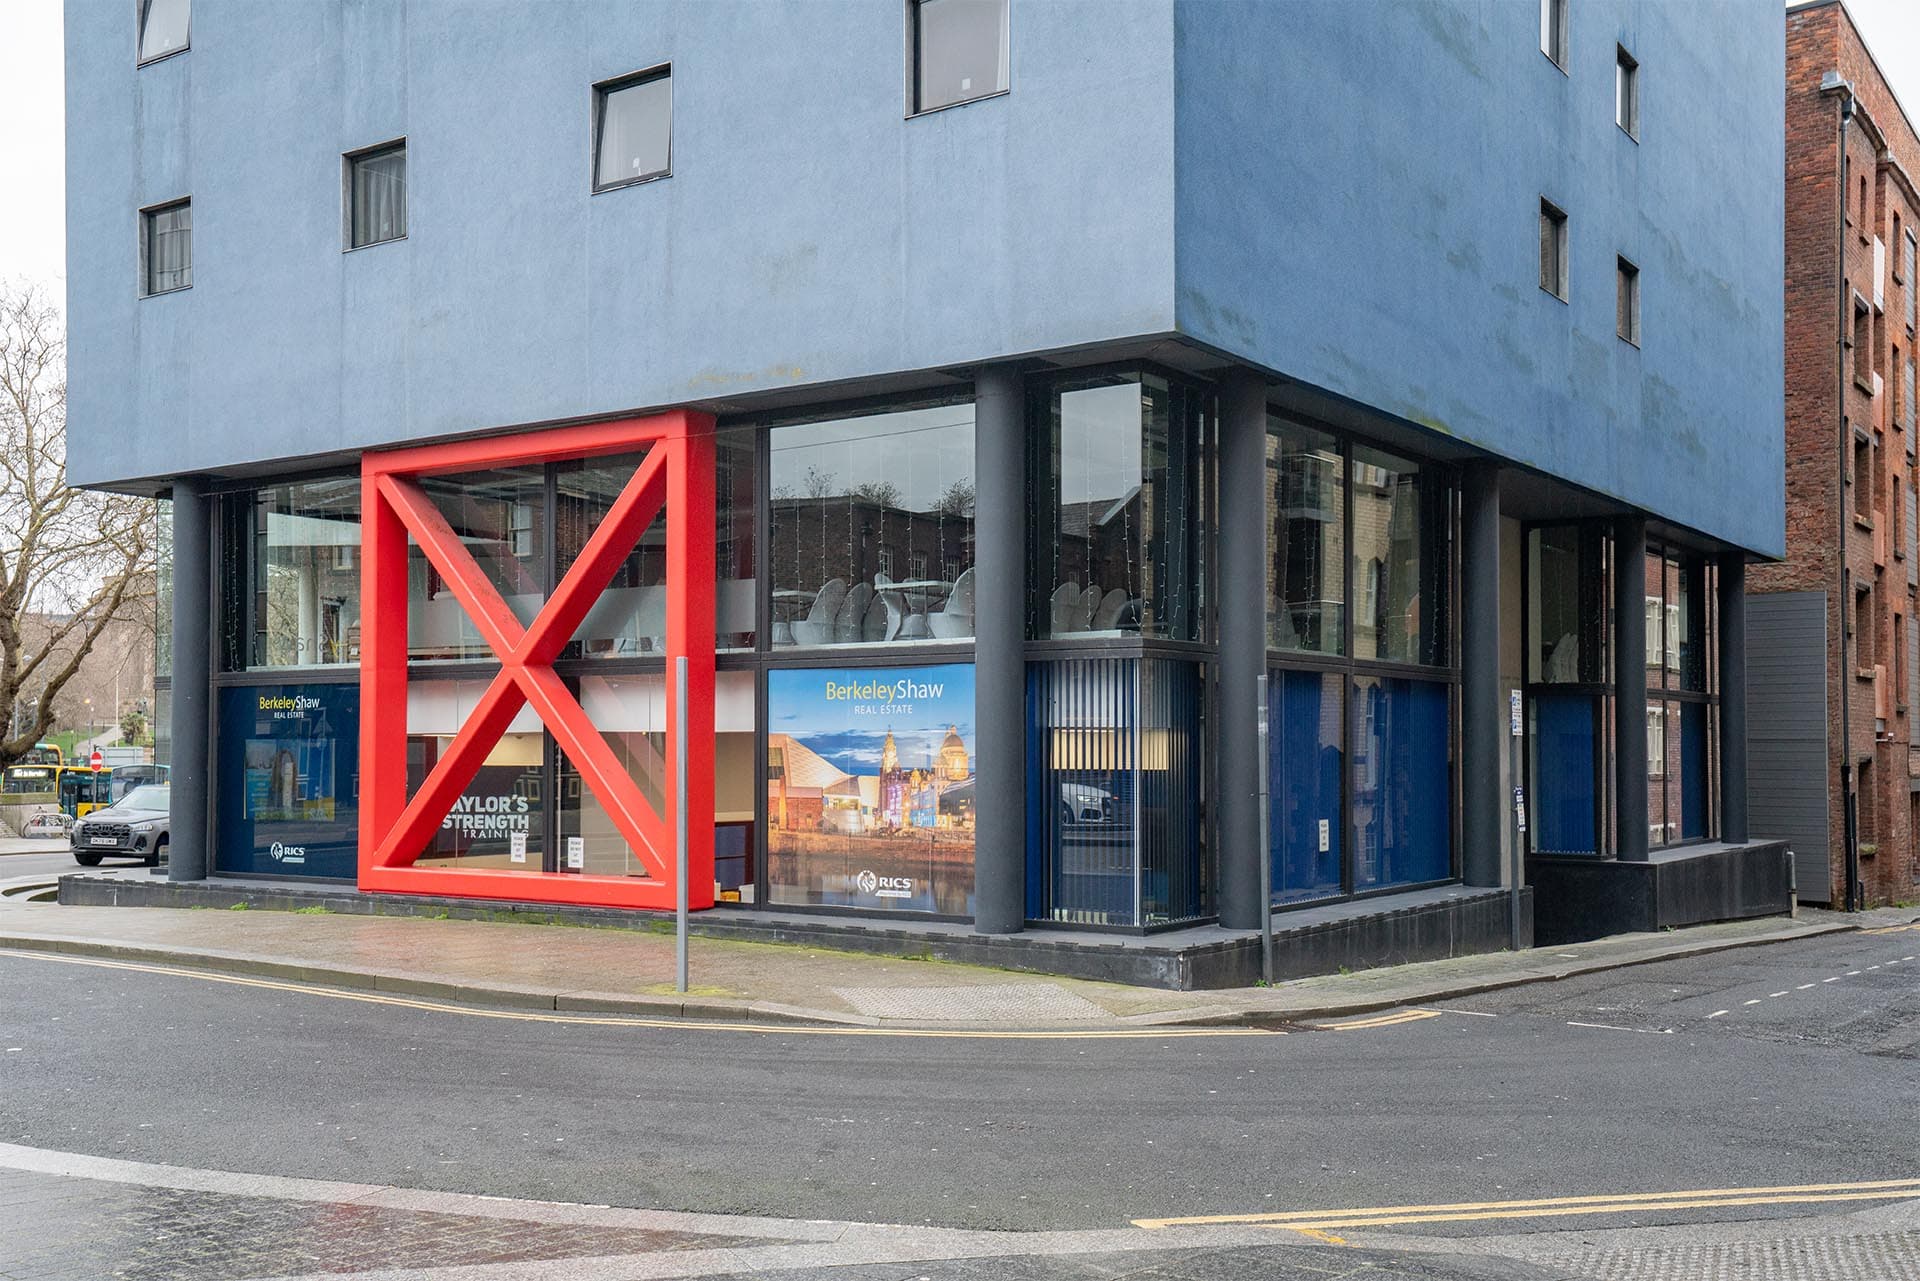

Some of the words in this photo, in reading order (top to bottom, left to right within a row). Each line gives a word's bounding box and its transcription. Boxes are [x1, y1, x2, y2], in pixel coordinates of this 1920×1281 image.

[826, 679, 943, 704] BerkeleyShaw
[259, 696, 320, 711] BerkeleyShaw
[855, 705, 877, 715] REAL
[880, 705, 913, 714] ESTATE
[274, 711, 287, 719] REAL
[287, 711, 304, 719] ESTATE
[450, 794, 529, 813] AYLOR'S
[442, 814, 529, 830] STRENGTH
[284, 846, 305, 856] RICS
[879, 877, 912, 889] RICS
